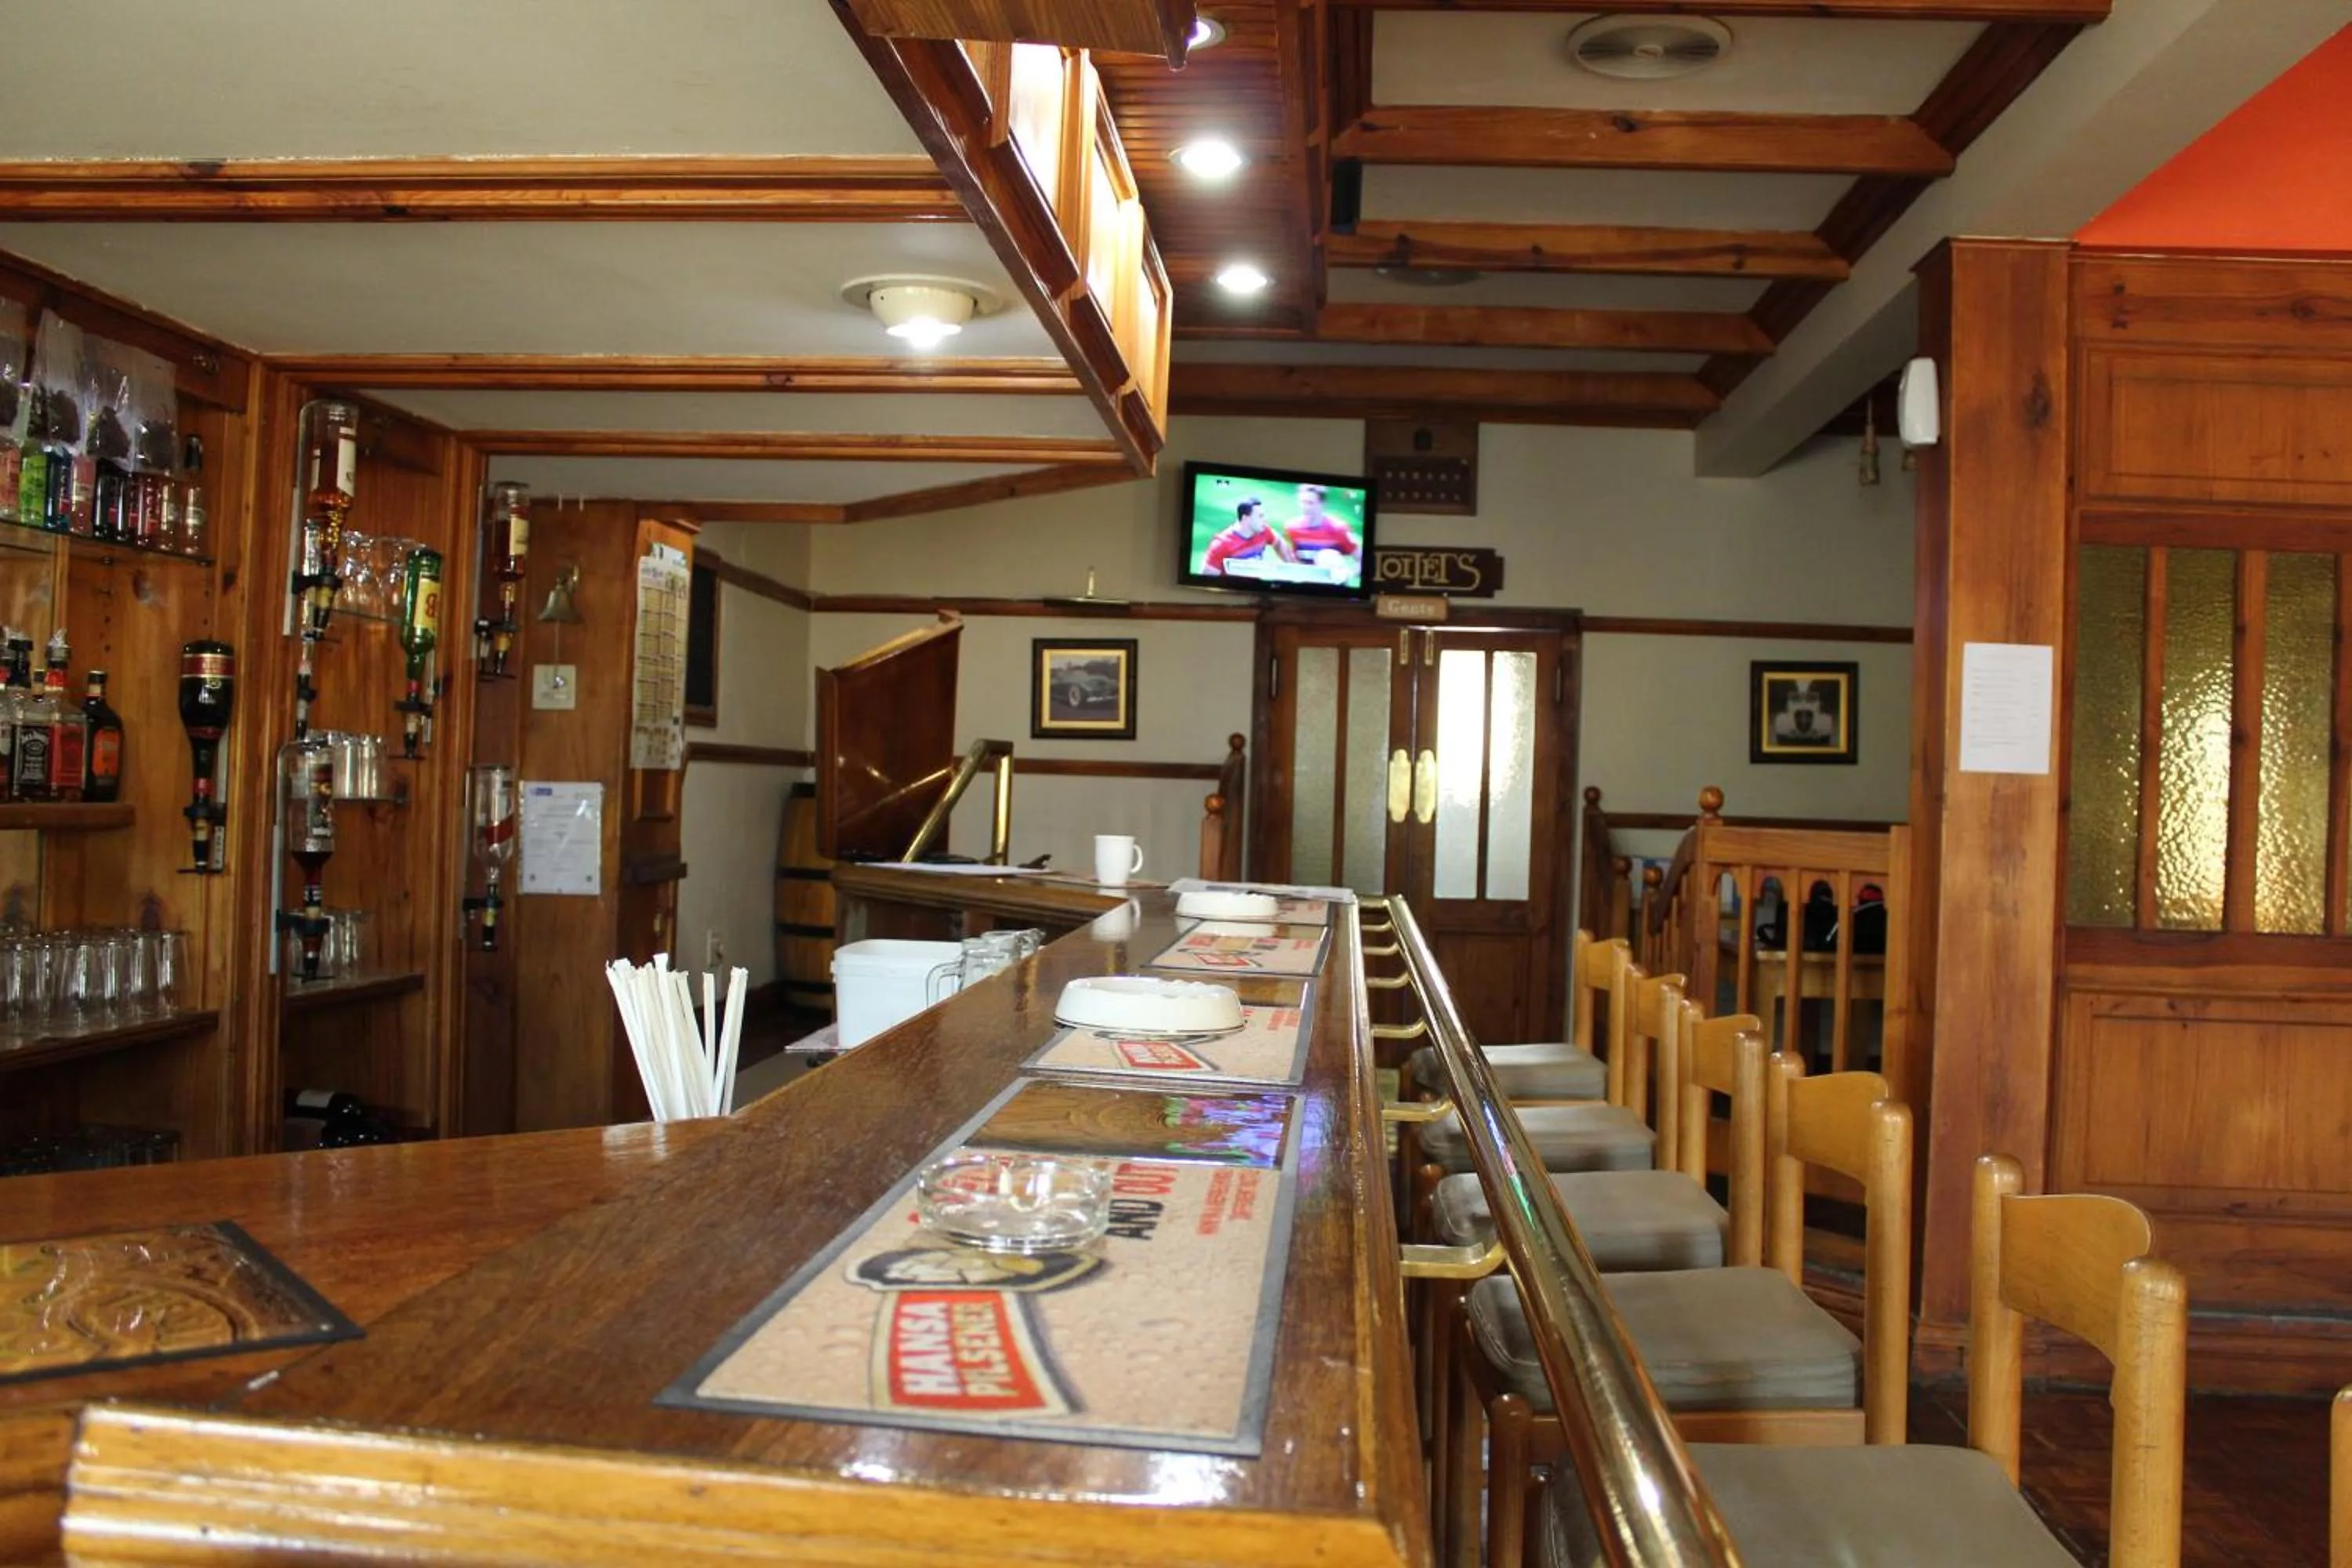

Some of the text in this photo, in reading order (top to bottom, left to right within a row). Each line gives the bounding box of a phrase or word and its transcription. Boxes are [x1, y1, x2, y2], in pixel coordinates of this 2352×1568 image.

[1104, 1163, 1179, 1240] AND OUT
[898, 1301, 962, 1396] HANSA
[953, 1301, 1020, 1396] PILSENER
